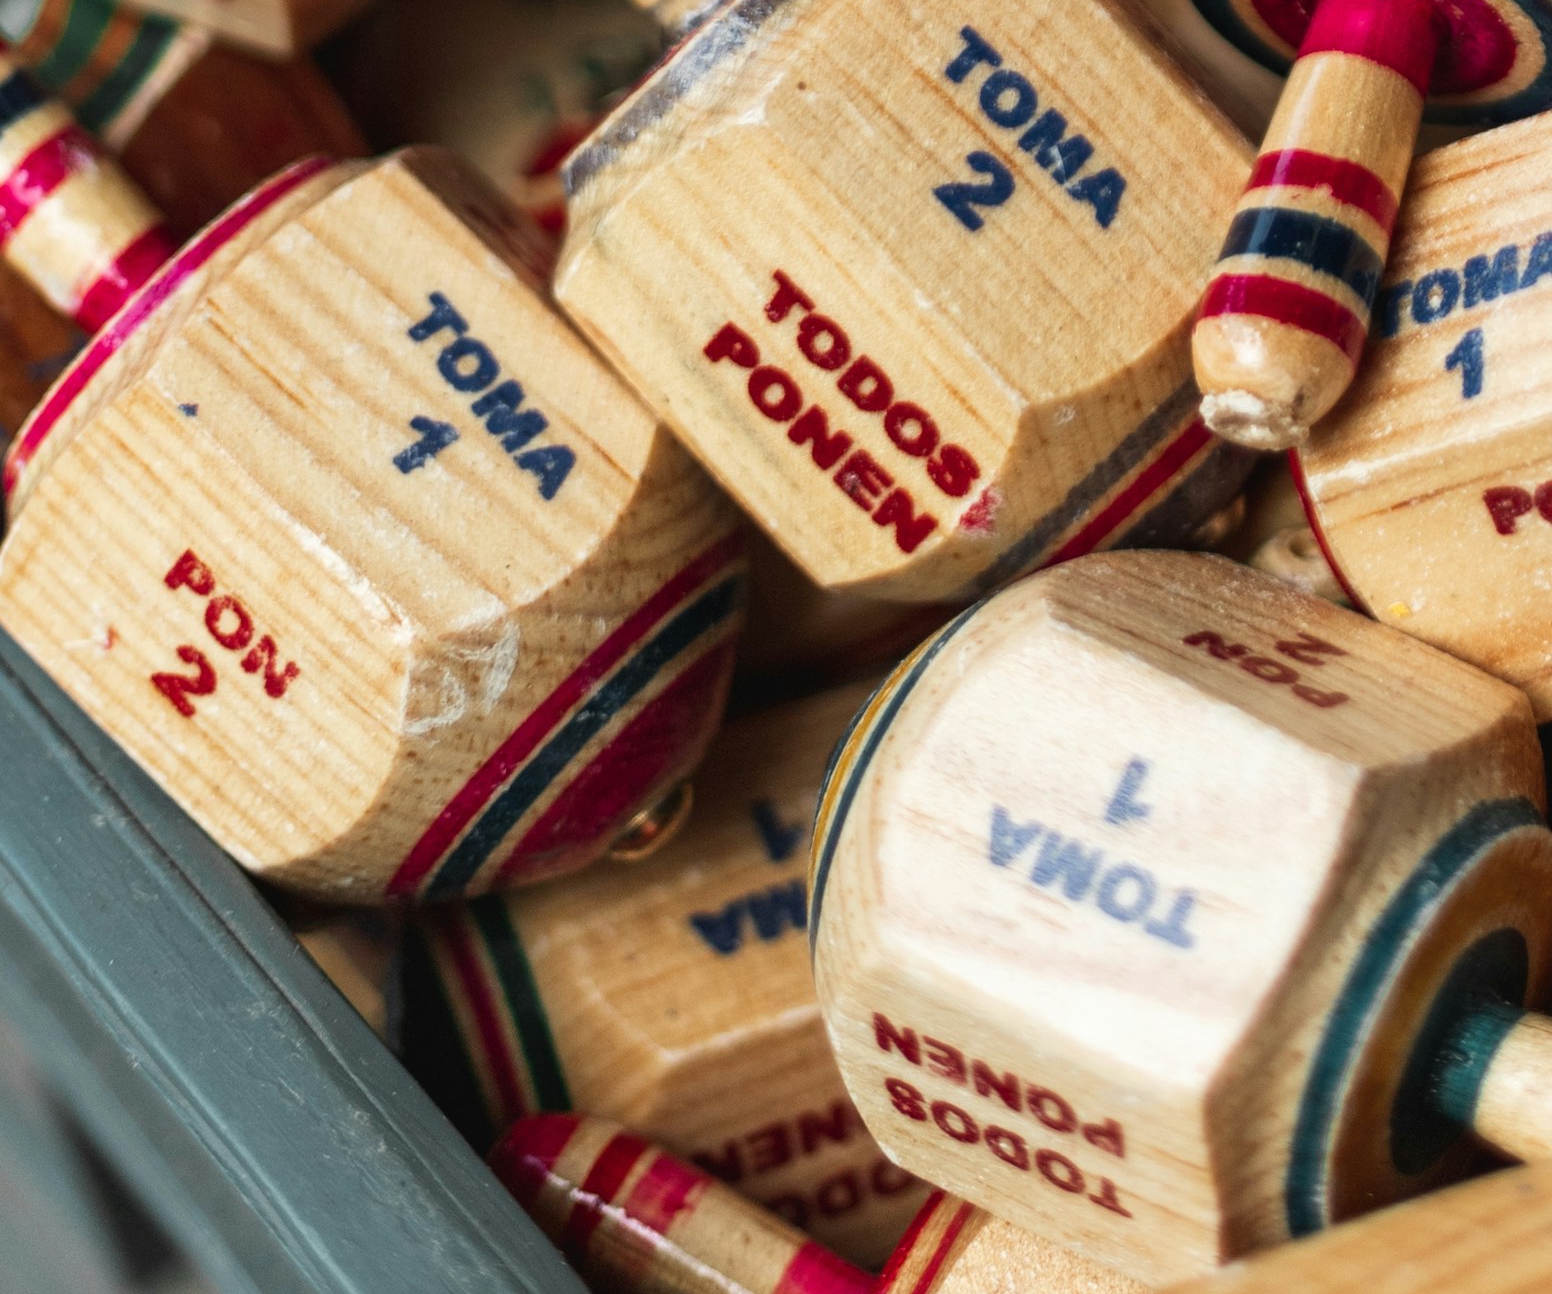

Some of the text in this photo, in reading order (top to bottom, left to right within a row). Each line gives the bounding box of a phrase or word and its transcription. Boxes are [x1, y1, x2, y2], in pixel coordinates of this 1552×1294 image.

[932, 150, 1016, 232] 2
[944, 25, 1128, 229] TOMA
[407, 291, 577, 501] TOMA
[764, 268, 981, 498] TODOS
[1446, 327, 1483, 399] 1
[392, 415, 460, 475] 1
[704, 322, 939, 554] PONEN
[150, 644, 218, 720] 2
[163, 548, 302, 700] PON
[1180, 630, 1350, 710] PON
[1275, 633, 1349, 666] 2
[1106, 756, 1154, 827] 1
[987, 804, 1198, 950] TOMA
[872, 1013, 1126, 1159] PONEN
[884, 1076, 1132, 1219] TODOS
